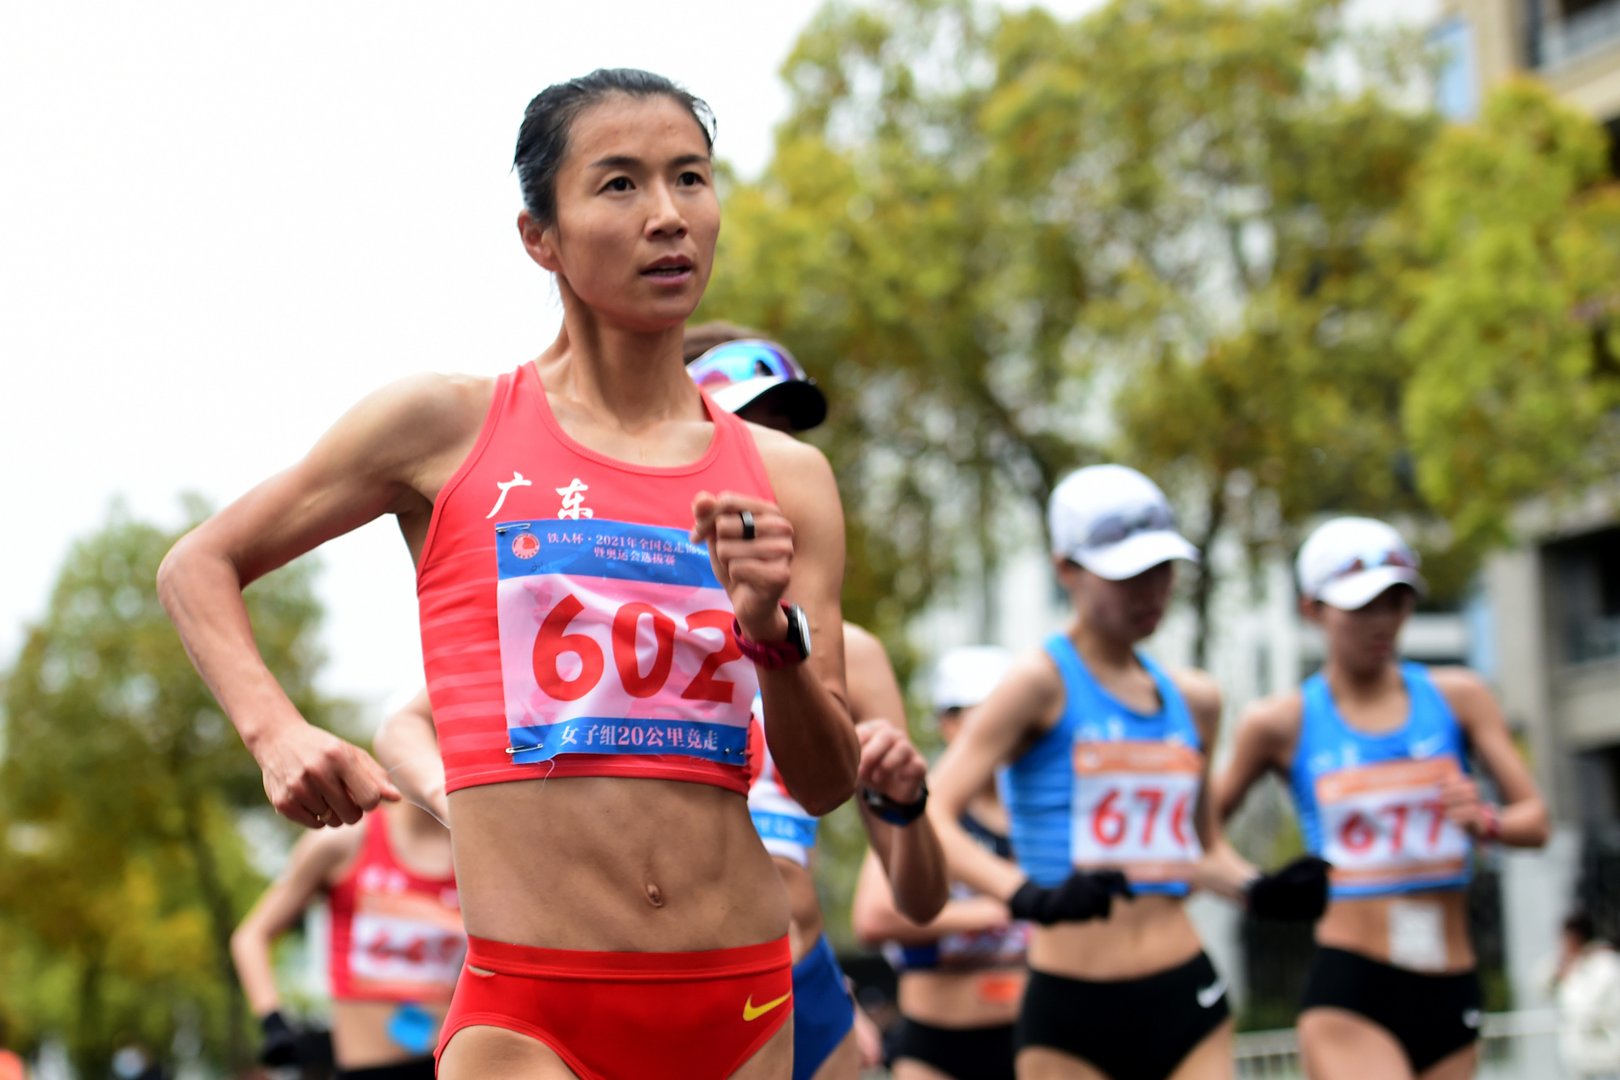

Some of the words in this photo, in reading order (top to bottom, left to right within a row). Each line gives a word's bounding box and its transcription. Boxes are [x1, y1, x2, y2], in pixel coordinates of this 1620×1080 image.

[486, 471, 594, 520] 广东
[532, 594, 743, 704] 602
[560, 724, 718, 752] 女子组20公里竞走
